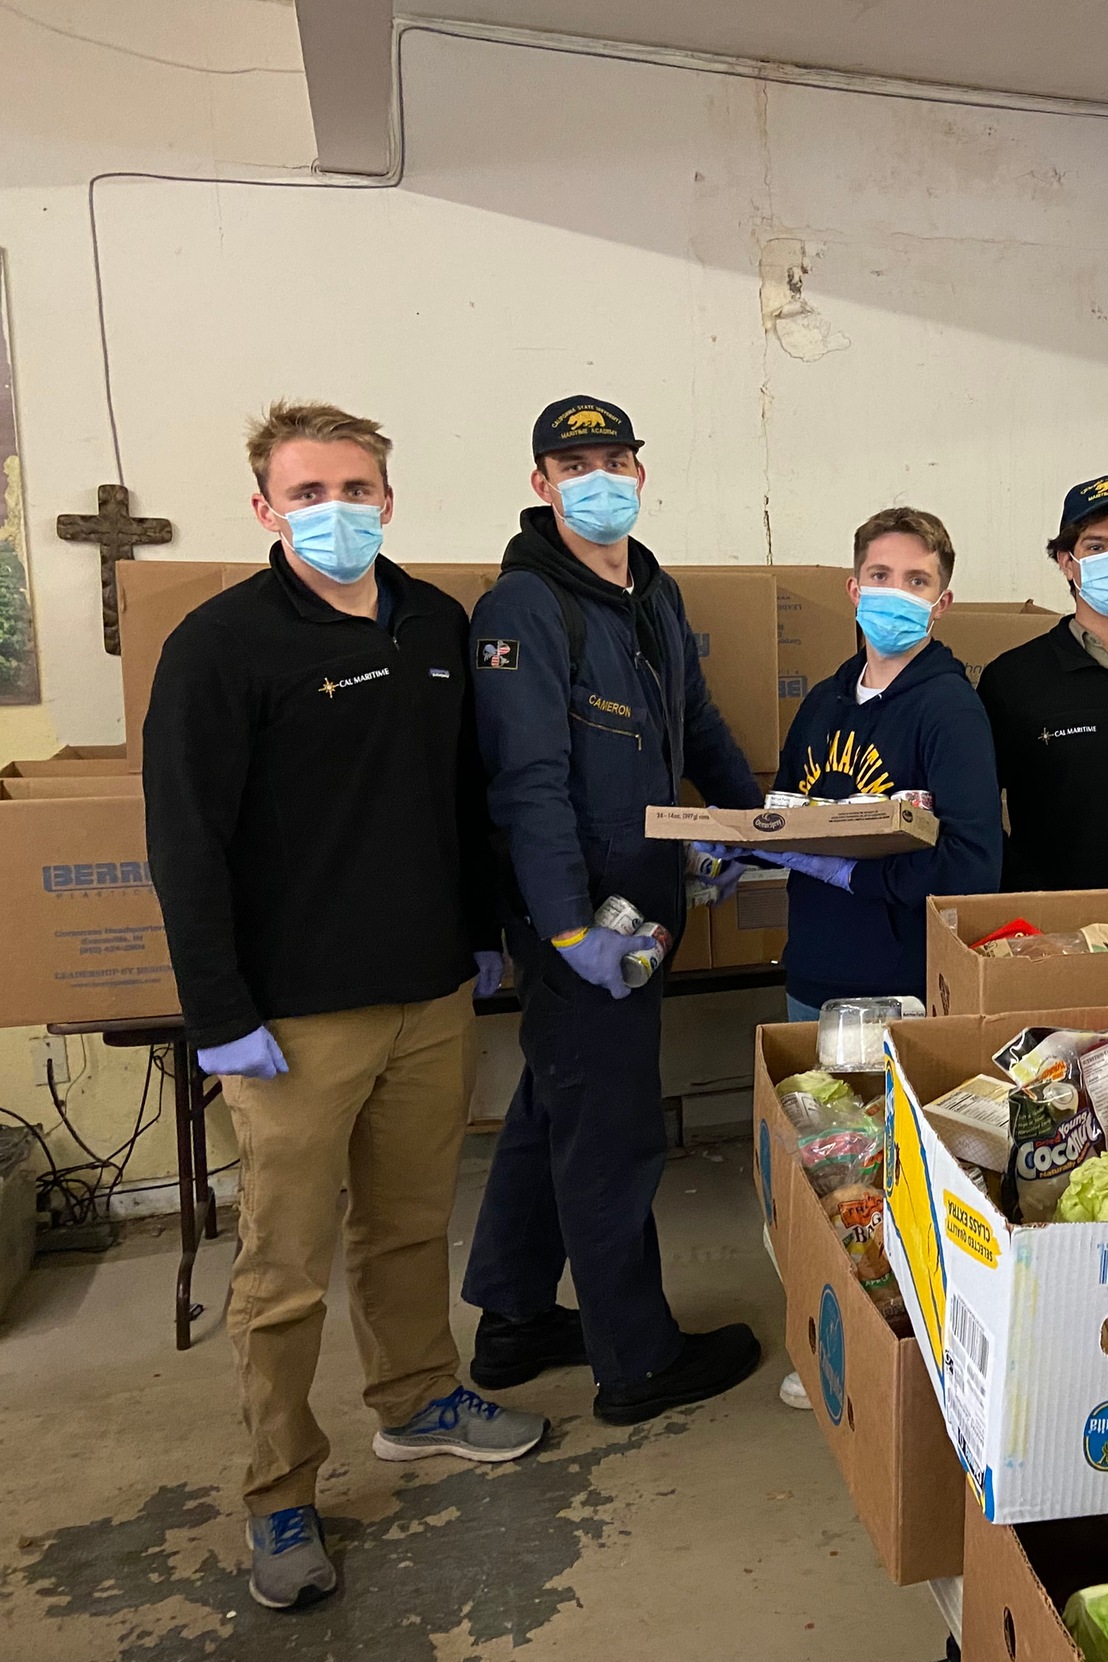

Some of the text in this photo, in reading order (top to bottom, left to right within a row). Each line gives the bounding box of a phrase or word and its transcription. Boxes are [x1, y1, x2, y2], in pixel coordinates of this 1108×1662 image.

[339, 668, 390, 688] CAL MARITIME
[588, 694, 632, 718] CAMERON
[1067, 726, 1096, 735] MARITIME
[1059, 1110, 1088, 1139] Young
[1016, 1112, 1101, 1180] Coconut
[1040, 1161, 1076, 1178] Naturally
[852, 1212, 882, 1242] BAG
[948, 1200, 991, 1243] CLASS EXTRA
[946, 1219, 993, 1262] SELECTED QUALITY
